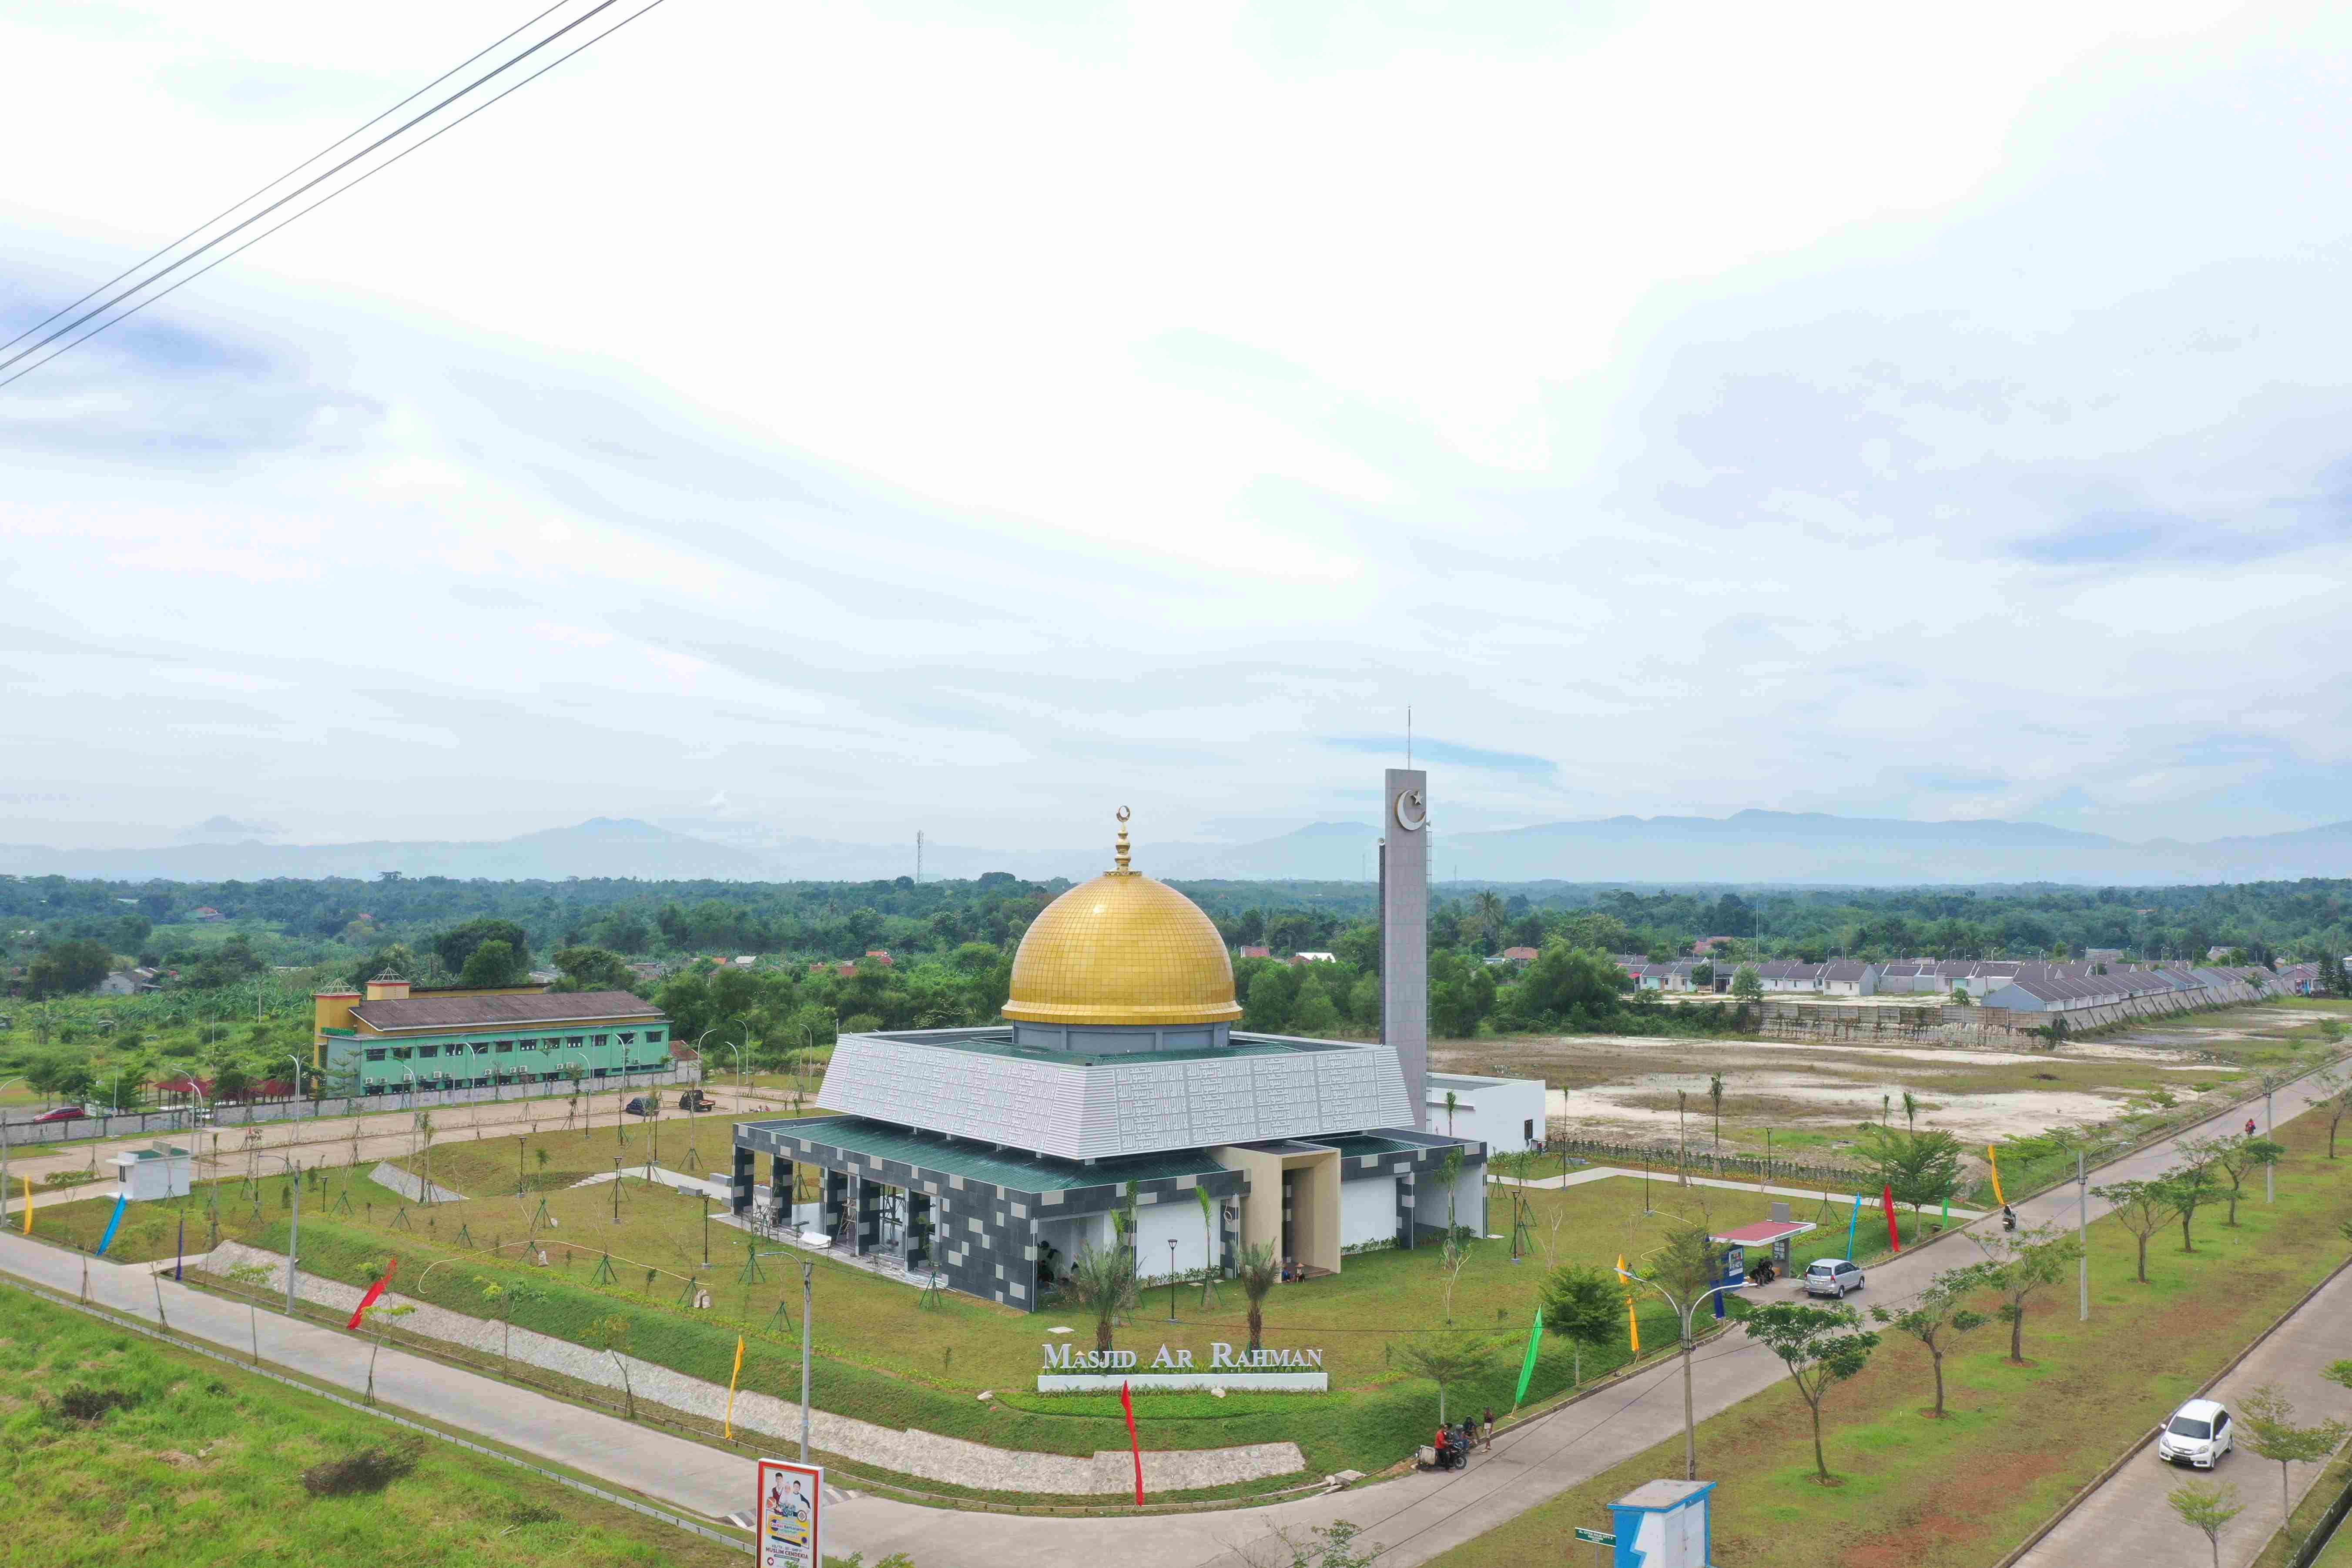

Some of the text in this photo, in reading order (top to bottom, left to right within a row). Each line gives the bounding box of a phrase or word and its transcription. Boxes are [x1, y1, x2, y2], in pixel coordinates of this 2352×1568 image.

[1042, 1343, 1323, 1369] MASJID AR RAHMAN
[785, 1551, 808, 1559] CENDEKIA
